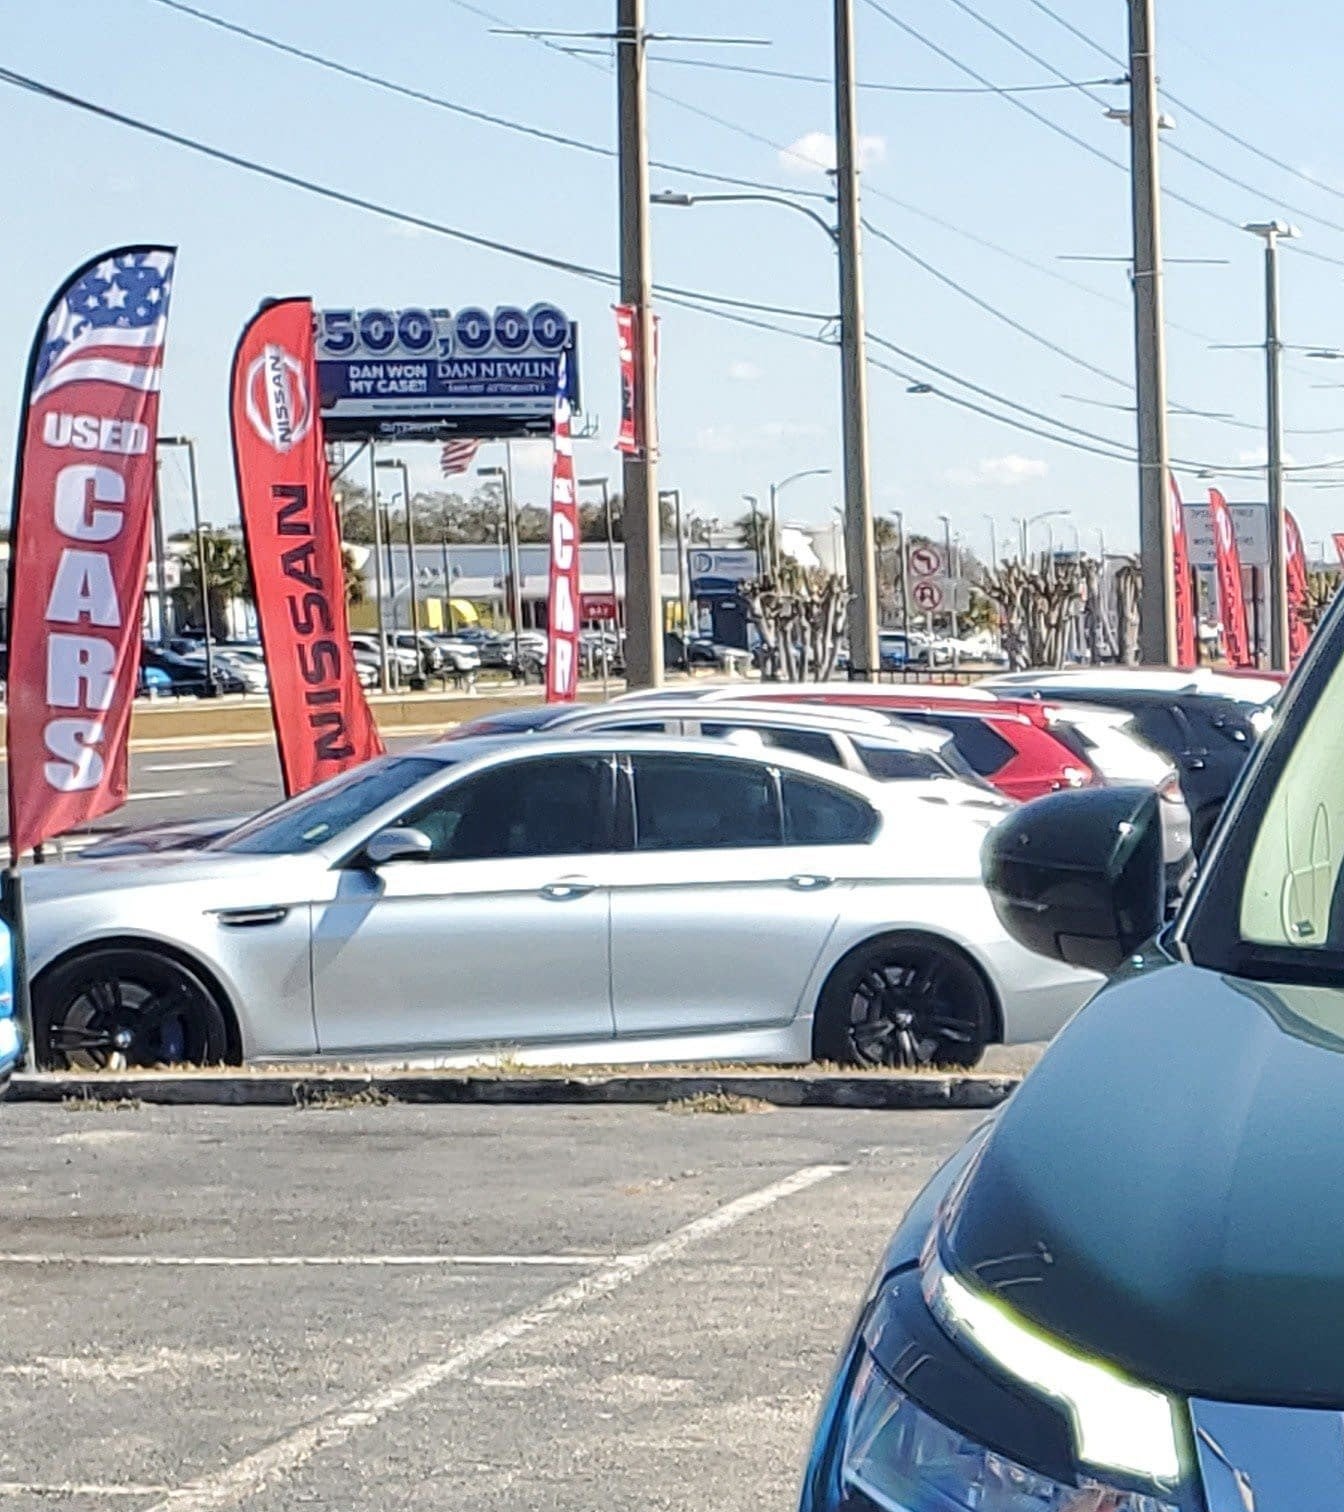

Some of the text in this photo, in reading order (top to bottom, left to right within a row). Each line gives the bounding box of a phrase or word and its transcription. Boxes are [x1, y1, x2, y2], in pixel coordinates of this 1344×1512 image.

[312, 304, 568, 358] 500,000
[349, 363, 428, 378] DAN WON
[349, 380, 374, 393] MY
[437, 362, 477, 378] DAN
[269, 355, 292, 443] NISSAN
[43, 411, 148, 455] USED
[44, 463, 127, 792] CARS
[271, 484, 355, 762] NISSAN
[553, 511, 575, 700] CAR
